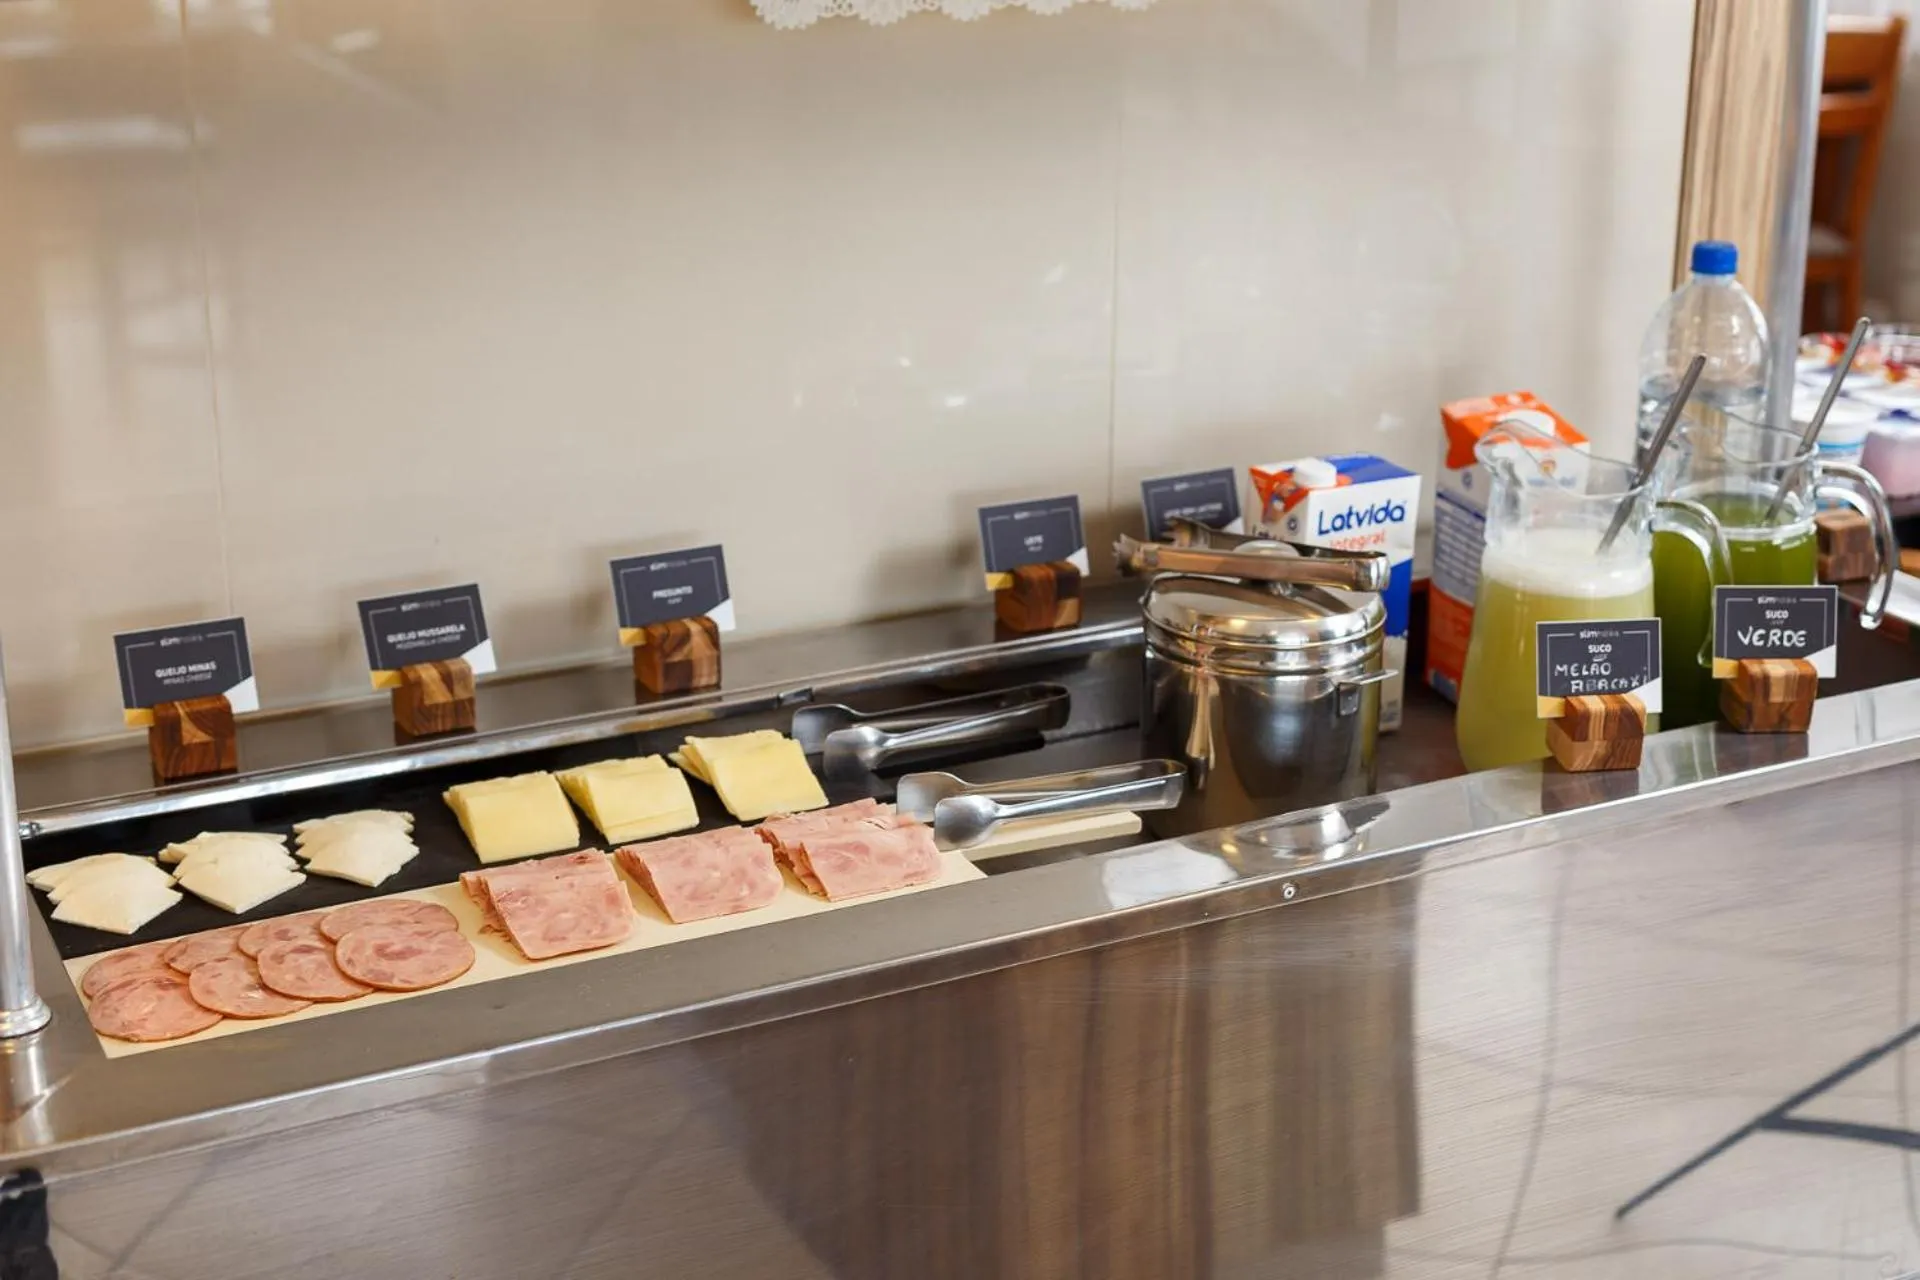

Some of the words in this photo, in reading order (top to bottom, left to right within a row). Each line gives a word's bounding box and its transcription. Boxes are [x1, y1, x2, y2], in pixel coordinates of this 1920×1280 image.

[1765, 609, 1789, 619] SUCO
[1737, 625, 1807, 648] VERDE
[1588, 643, 1613, 653] SUCO
[155, 664, 187, 678] QUEIJO
[188, 660, 217, 673] MINAS
